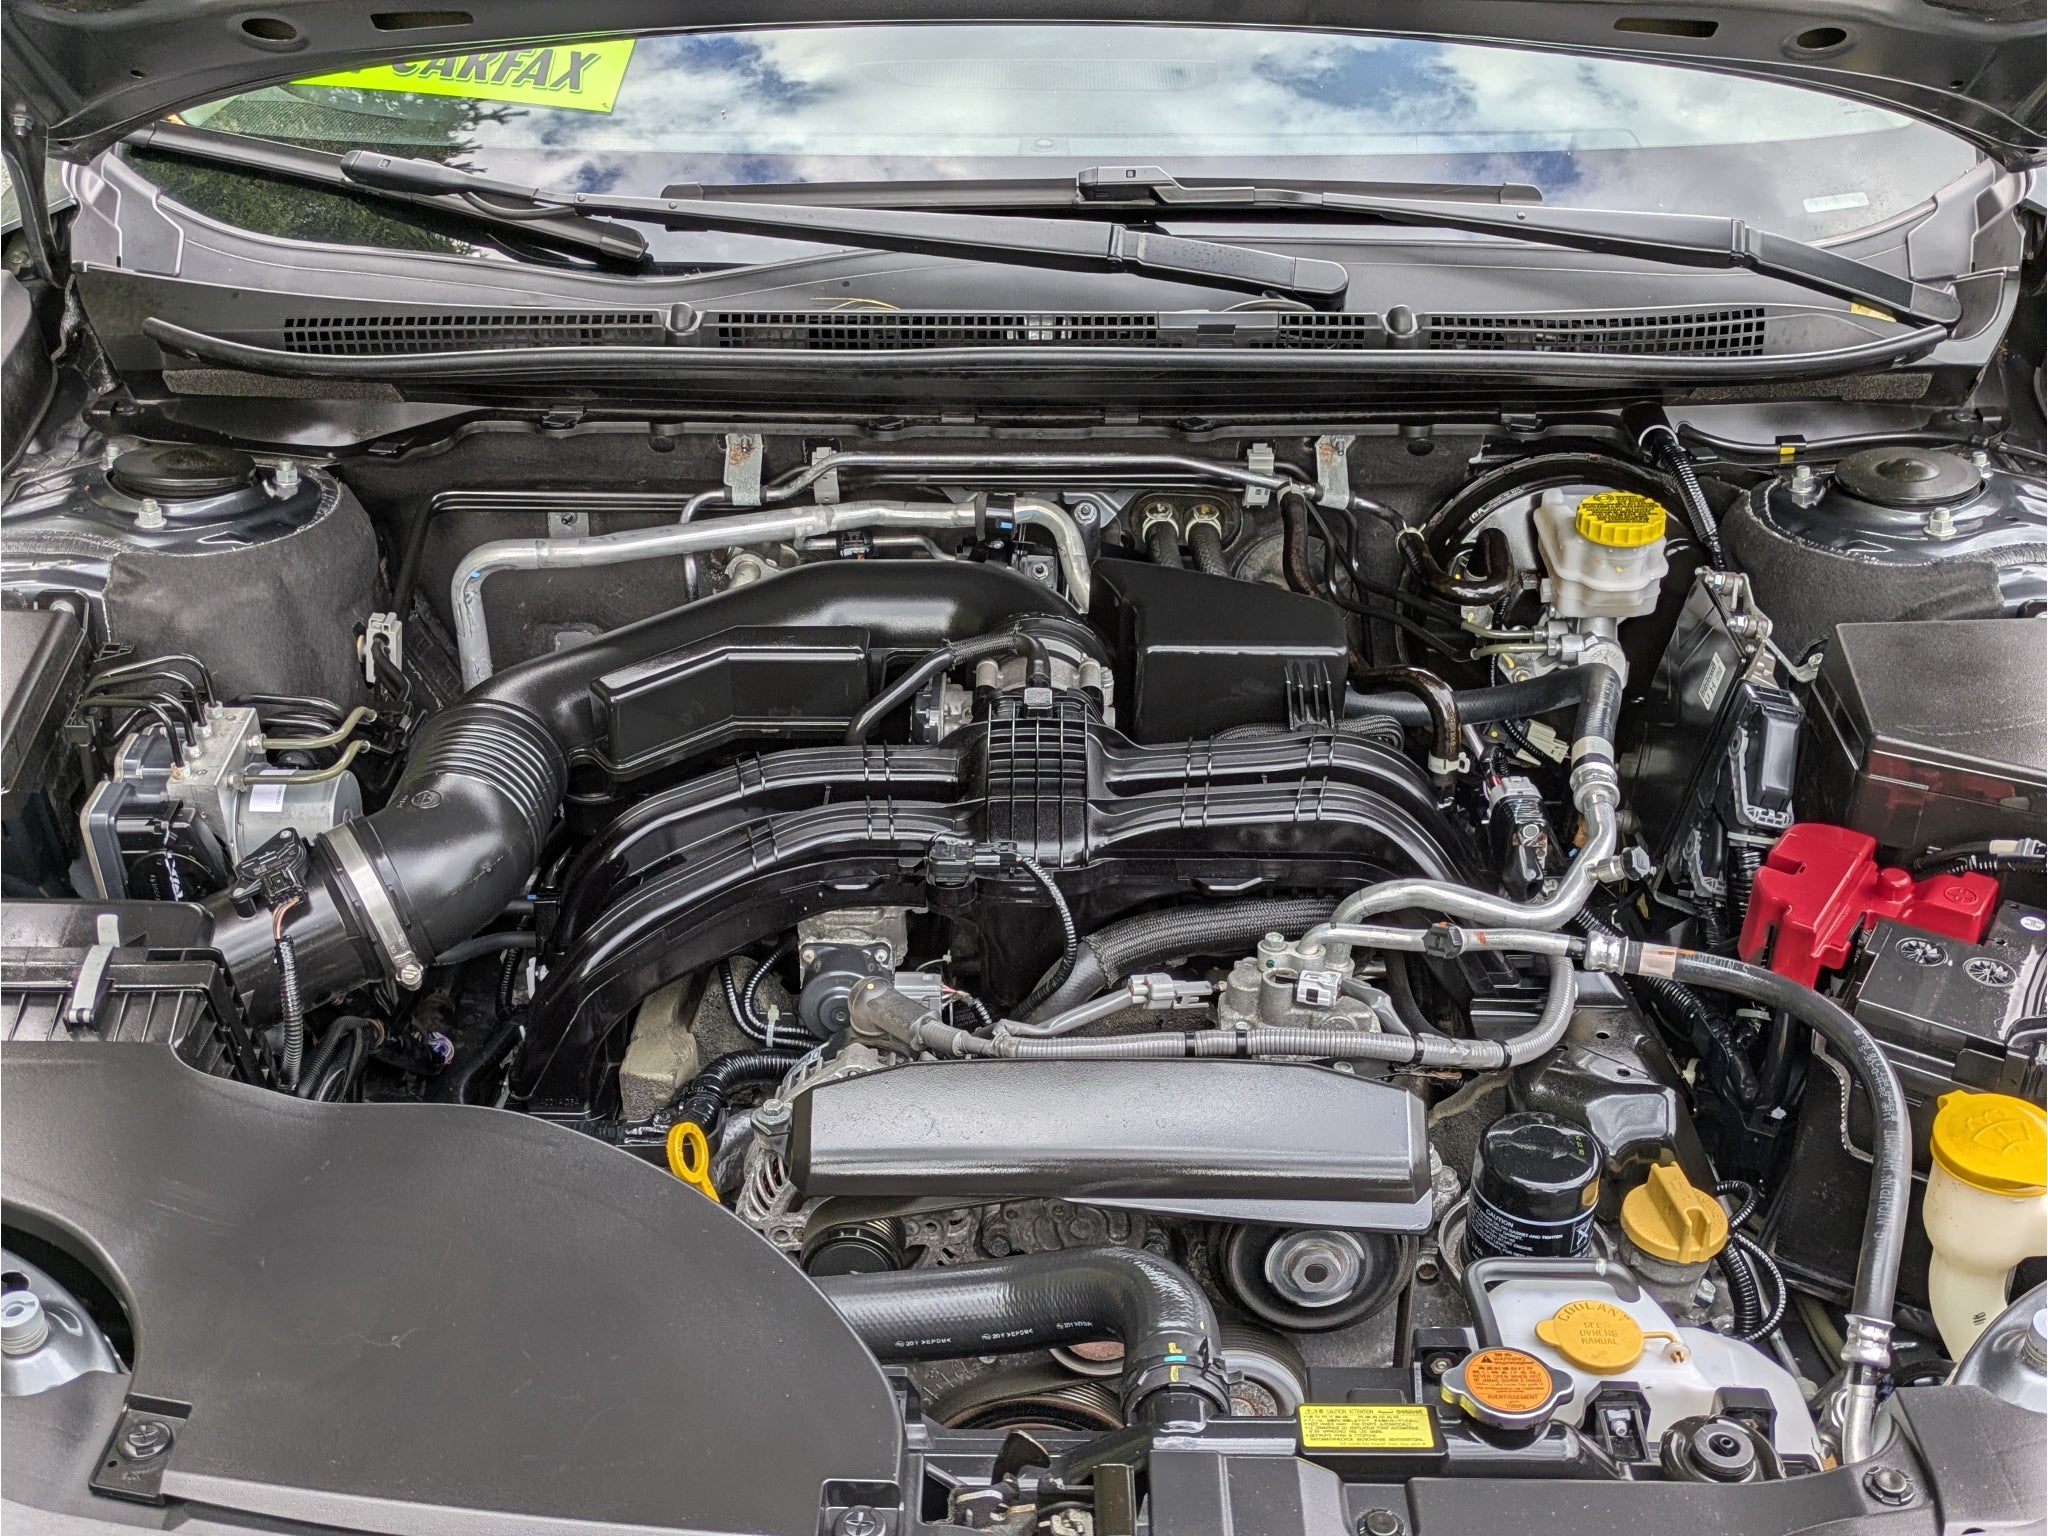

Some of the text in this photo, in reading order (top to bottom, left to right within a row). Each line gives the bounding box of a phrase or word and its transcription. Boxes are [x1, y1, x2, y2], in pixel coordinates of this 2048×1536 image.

[1485, 1208, 1514, 1228] CAUTION
[1508, 1228, 1530, 1239] GASKET
[1558, 1302, 1631, 1322] COOLANT
